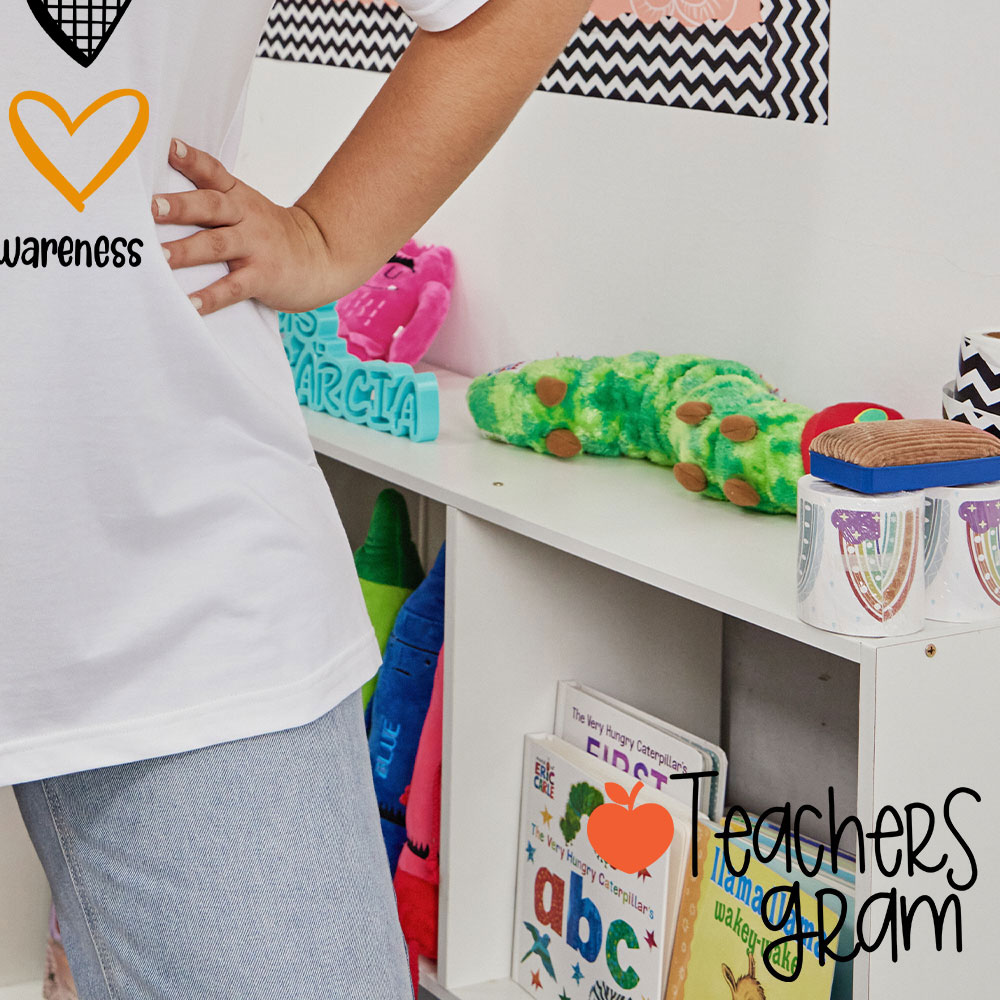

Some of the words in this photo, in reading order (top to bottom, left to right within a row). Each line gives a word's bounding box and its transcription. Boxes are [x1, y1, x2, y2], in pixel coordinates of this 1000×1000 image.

[295, 351, 419, 437] ARCIA
[374, 717, 402, 780] BLUE
[534, 761, 555, 786] ERIC
[572, 706, 586, 725] The
[586, 714, 605, 735] Very
[605, 723, 635, 752] Hungry
[636, 739, 689, 775] Caterpillar's
[533, 775, 555, 800] CARLE
[531, 822, 545, 843] The
[546, 836, 565, 861] Very
[566, 848, 597, 884] Hungry
[598, 872, 654, 920] Caterpillar's
[533, 866, 640, 991] abc
